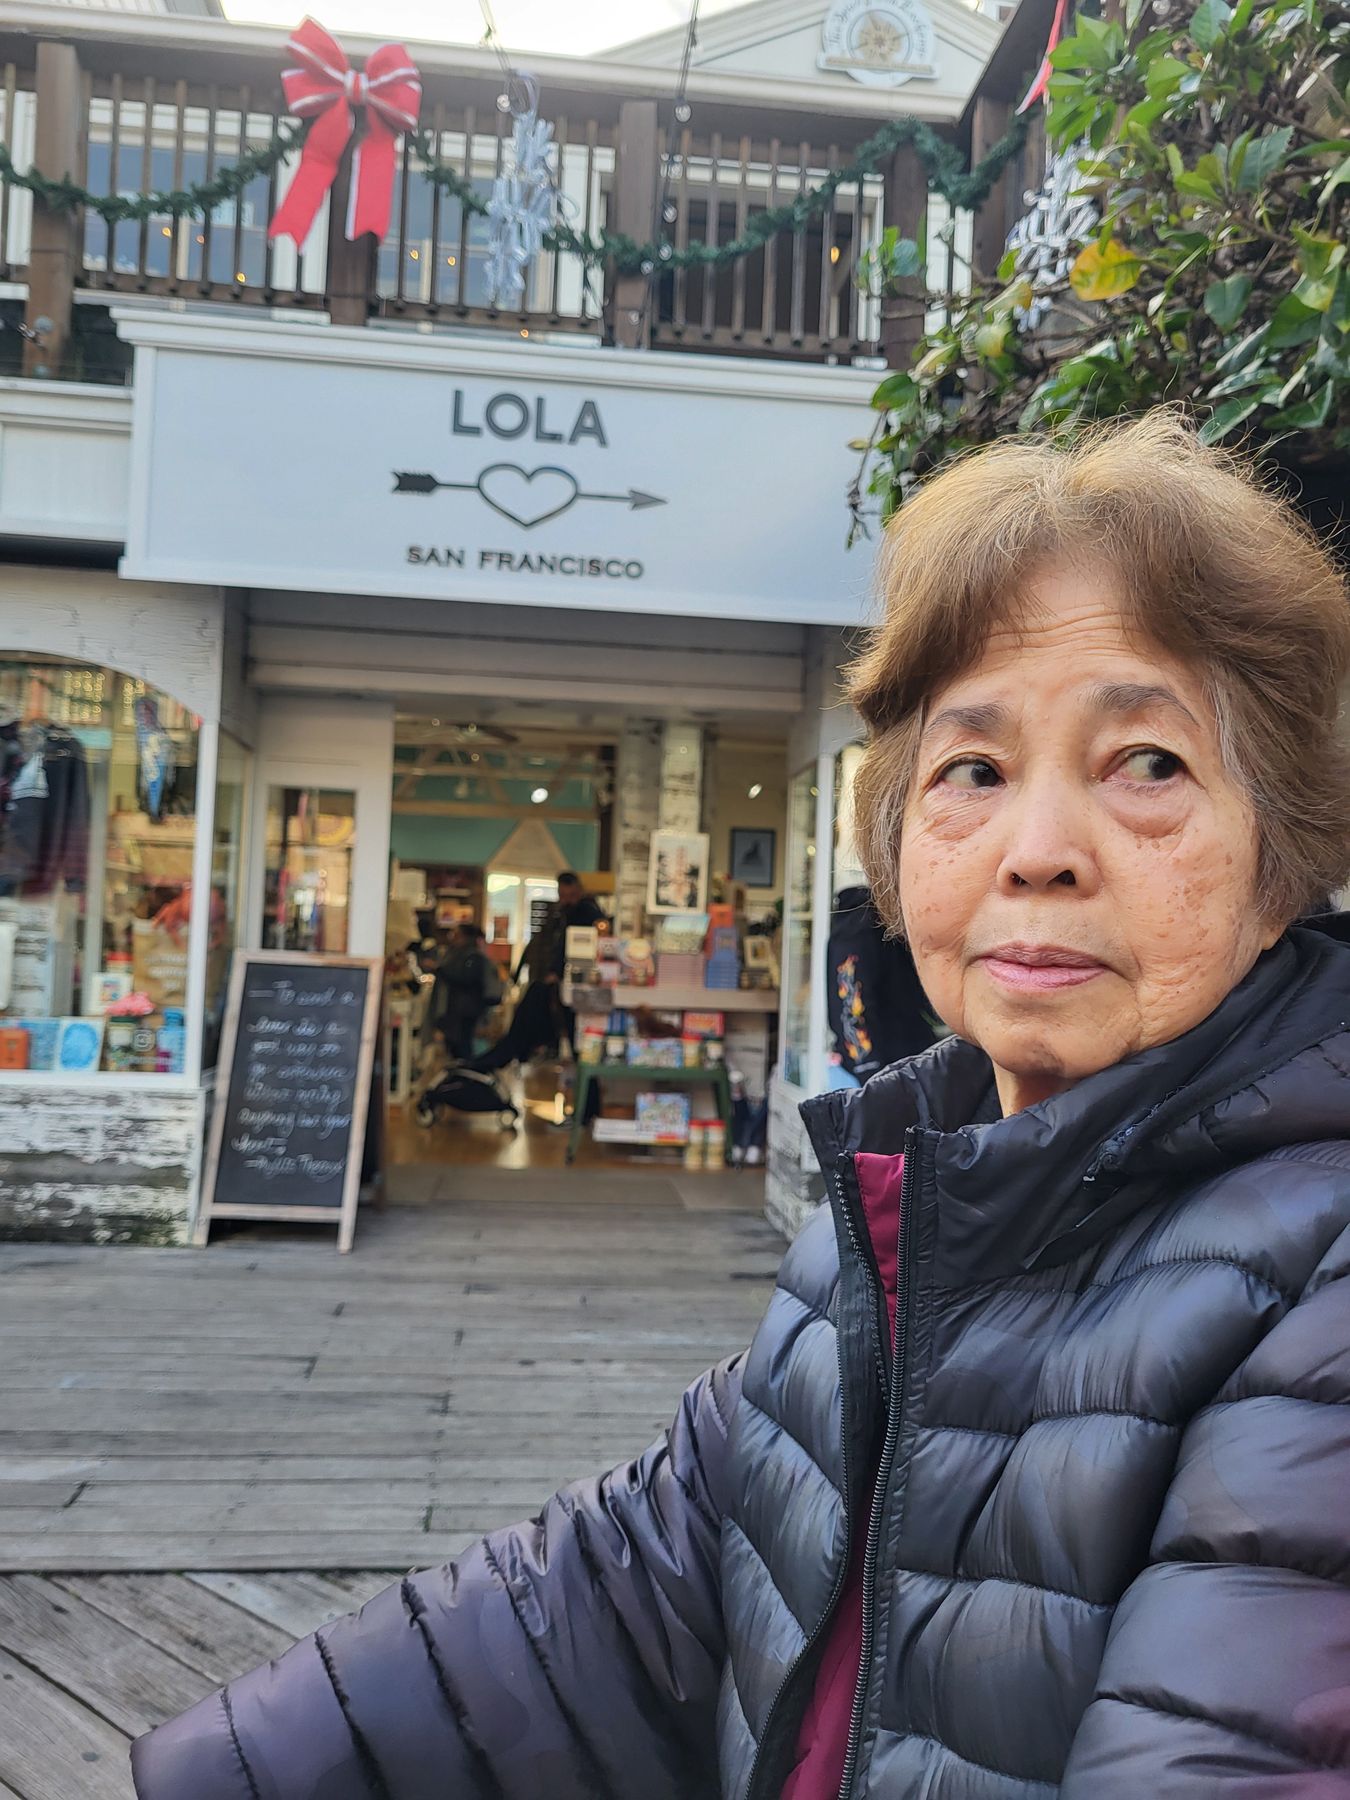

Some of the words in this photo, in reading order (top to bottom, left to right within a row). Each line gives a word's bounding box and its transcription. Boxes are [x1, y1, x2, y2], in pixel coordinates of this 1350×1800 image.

[452, 389, 608, 448] LOLA
[407, 545, 465, 568] SAN
[477, 550, 644, 579] FRANCISCO
